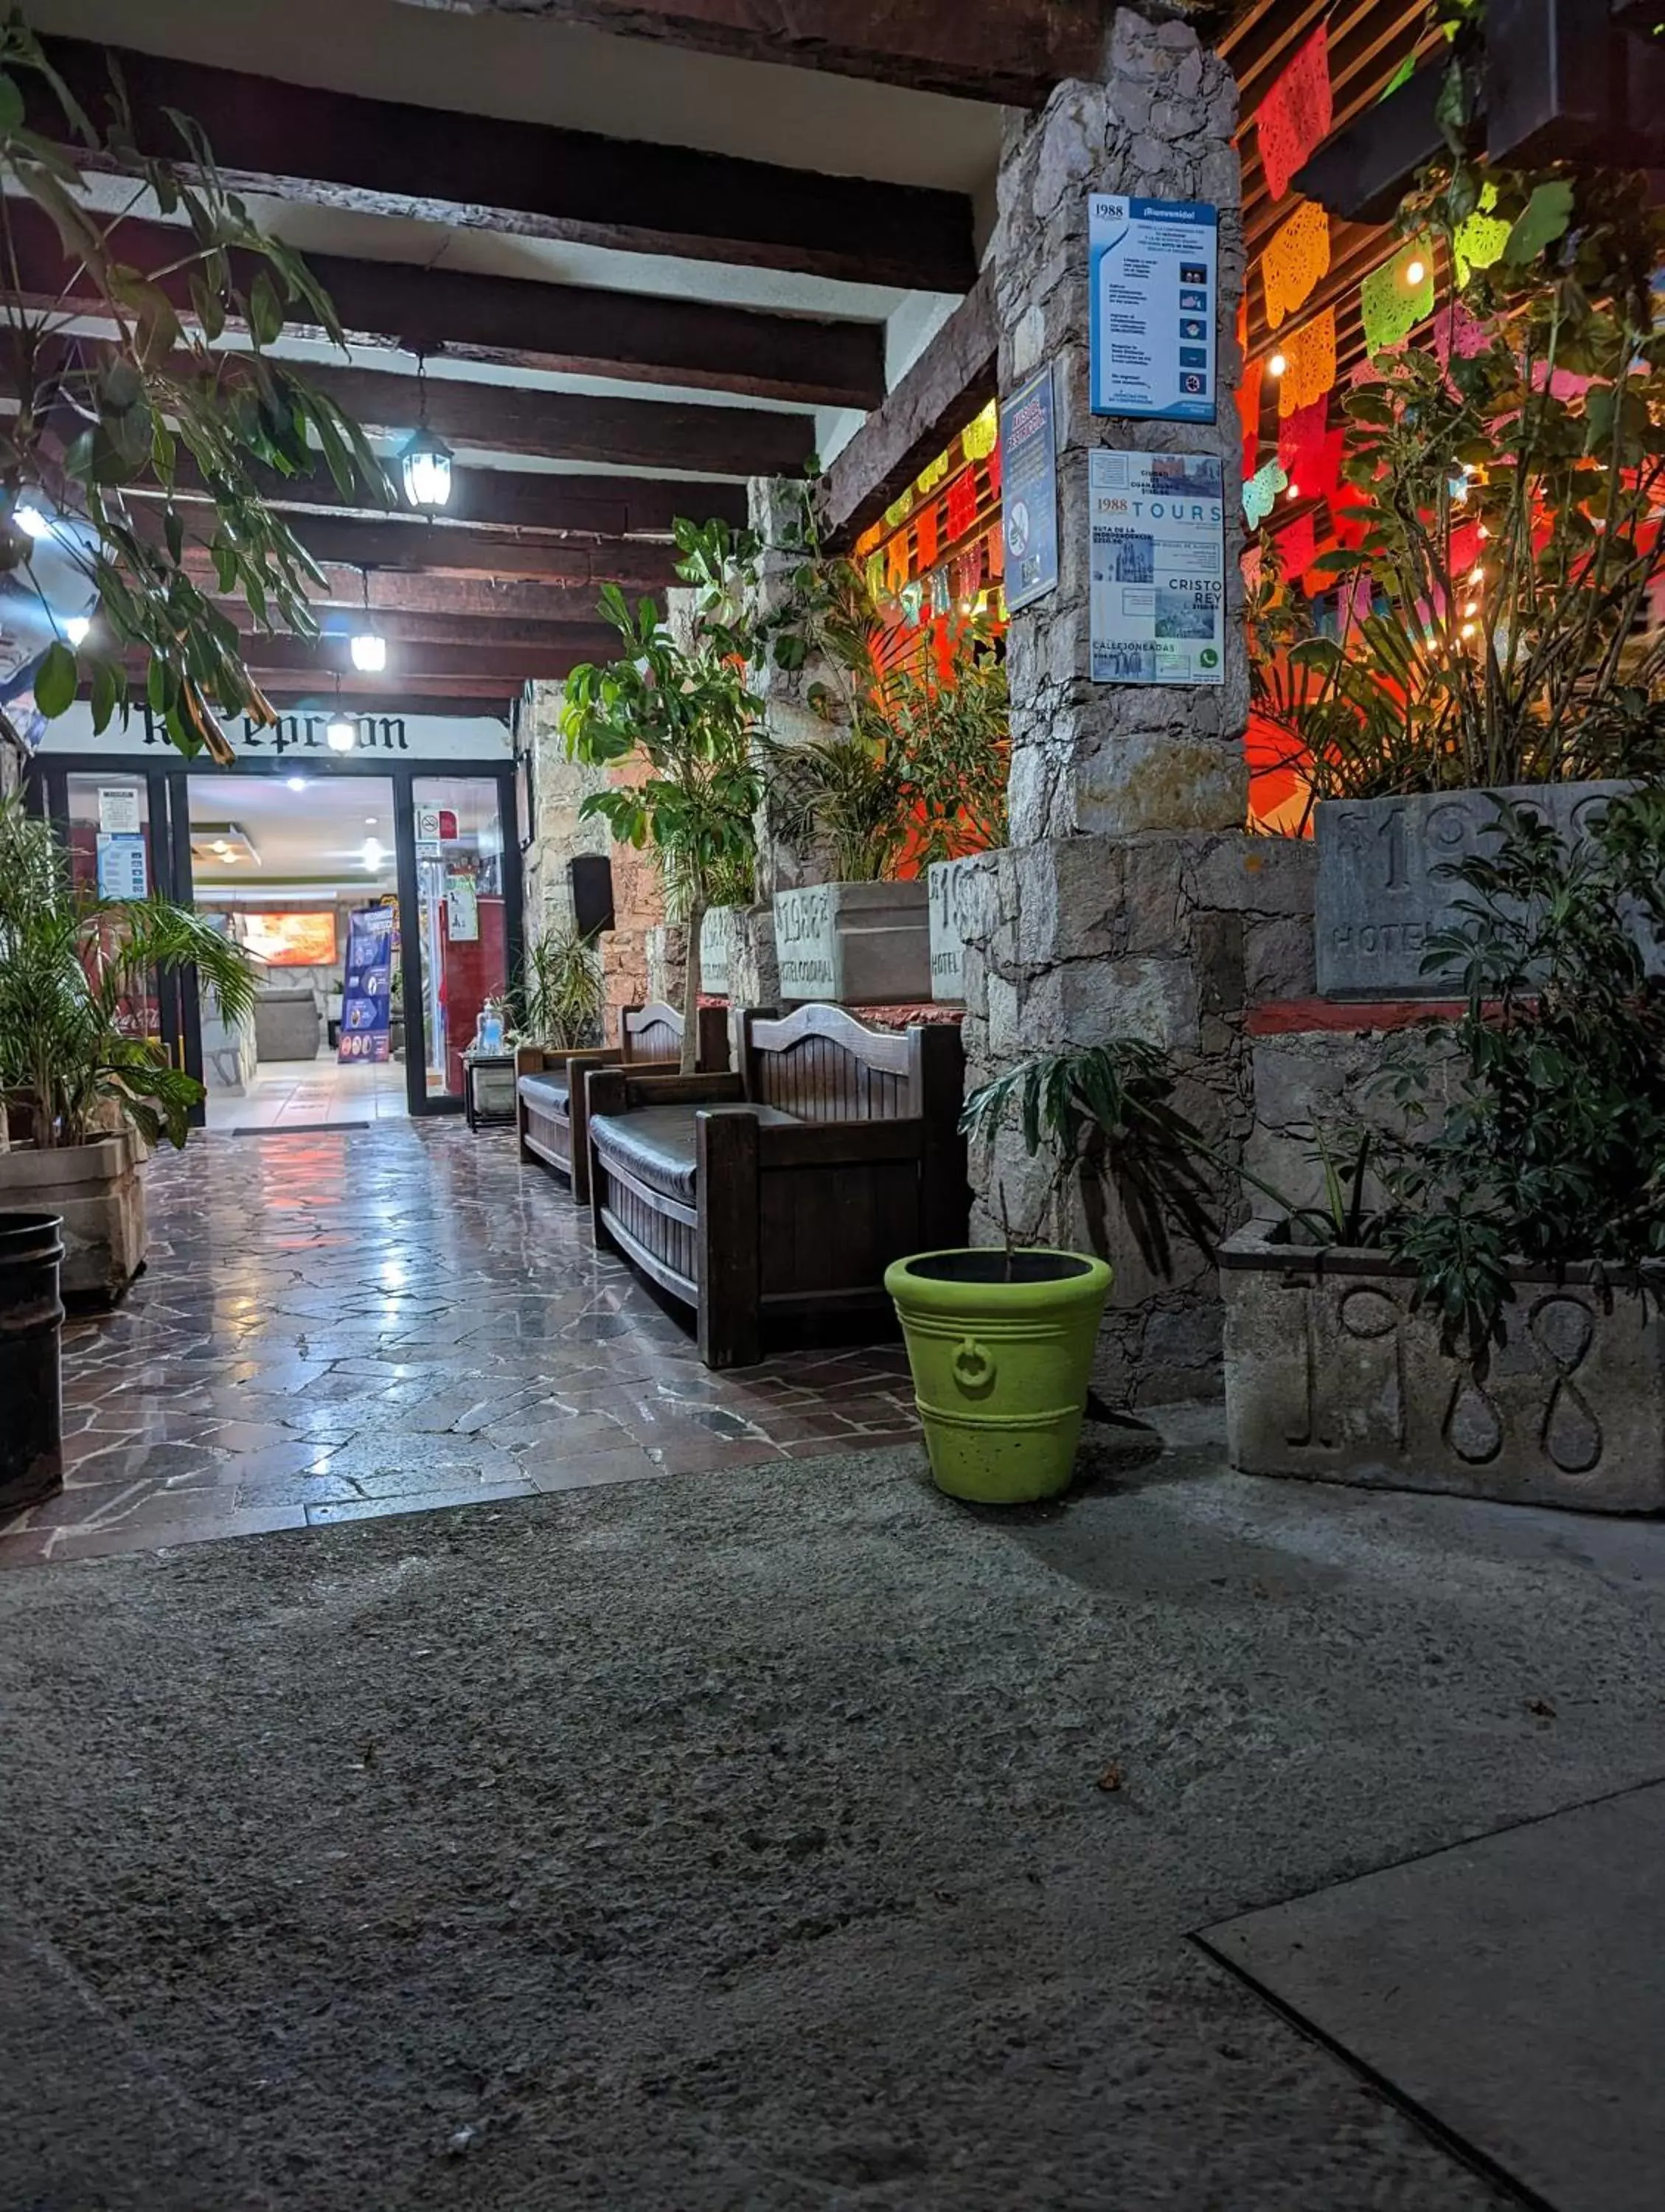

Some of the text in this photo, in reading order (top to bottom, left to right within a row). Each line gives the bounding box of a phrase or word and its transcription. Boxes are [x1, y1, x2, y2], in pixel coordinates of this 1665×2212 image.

[1096, 204, 1123, 216] 1988
[1097, 498, 1222, 521] 1988 TOURS
[1169, 579, 1222, 591] CRISTO
[1195, 592, 1222, 604] REY
[1094, 641, 1175, 653] CALLEJONEADAS
[931, 951, 959, 976] HOTEL
